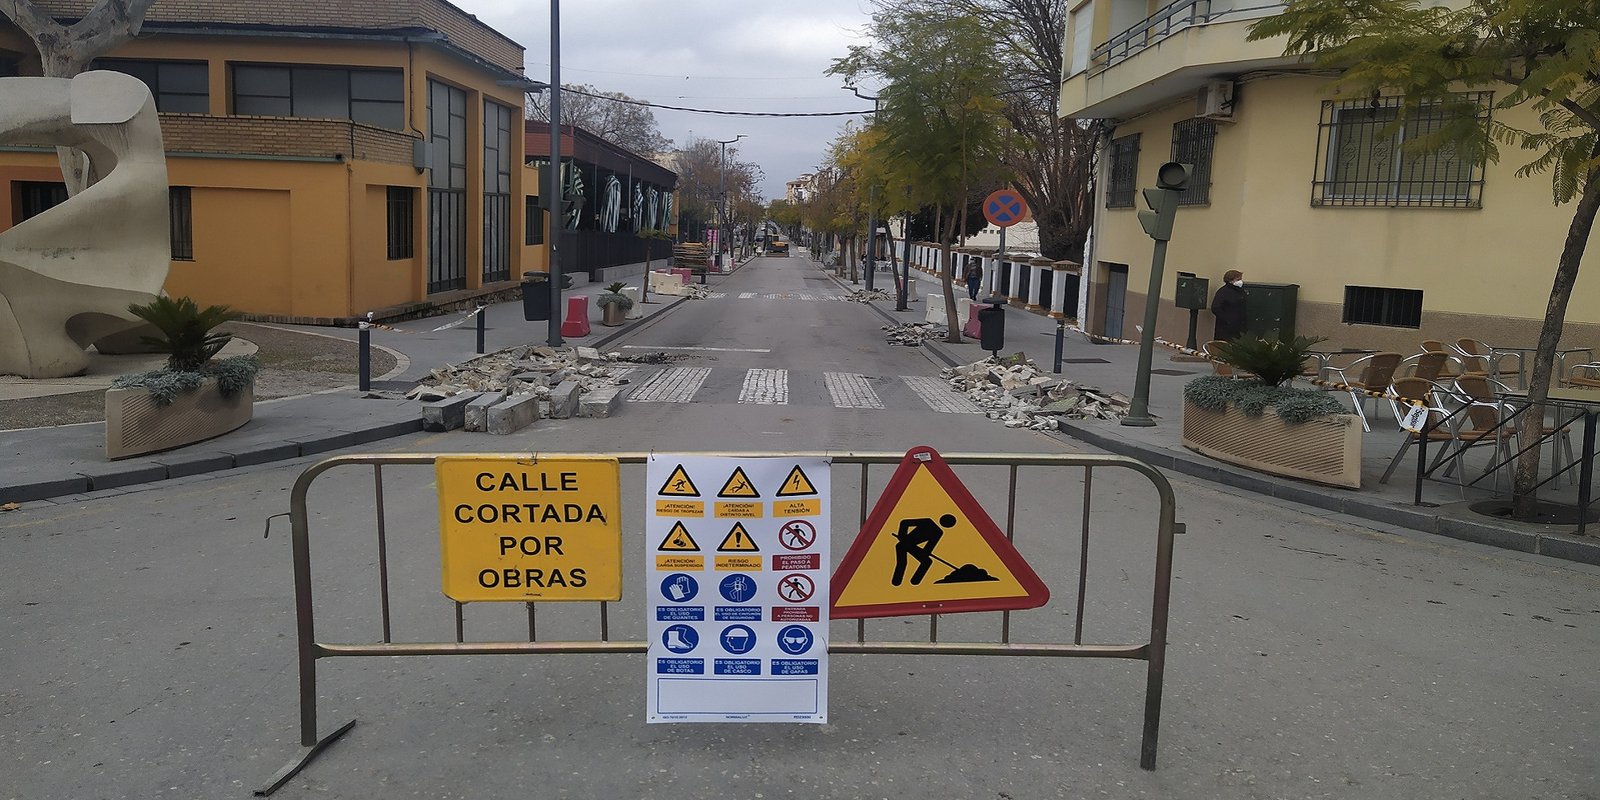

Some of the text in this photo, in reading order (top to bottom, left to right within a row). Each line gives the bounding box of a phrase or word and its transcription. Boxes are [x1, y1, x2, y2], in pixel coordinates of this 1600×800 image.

[476, 473, 578, 491] CALLE
[455, 504, 607, 523] CORTADA
[500, 536, 564, 555] POR
[479, 568, 587, 588] OBRAS
